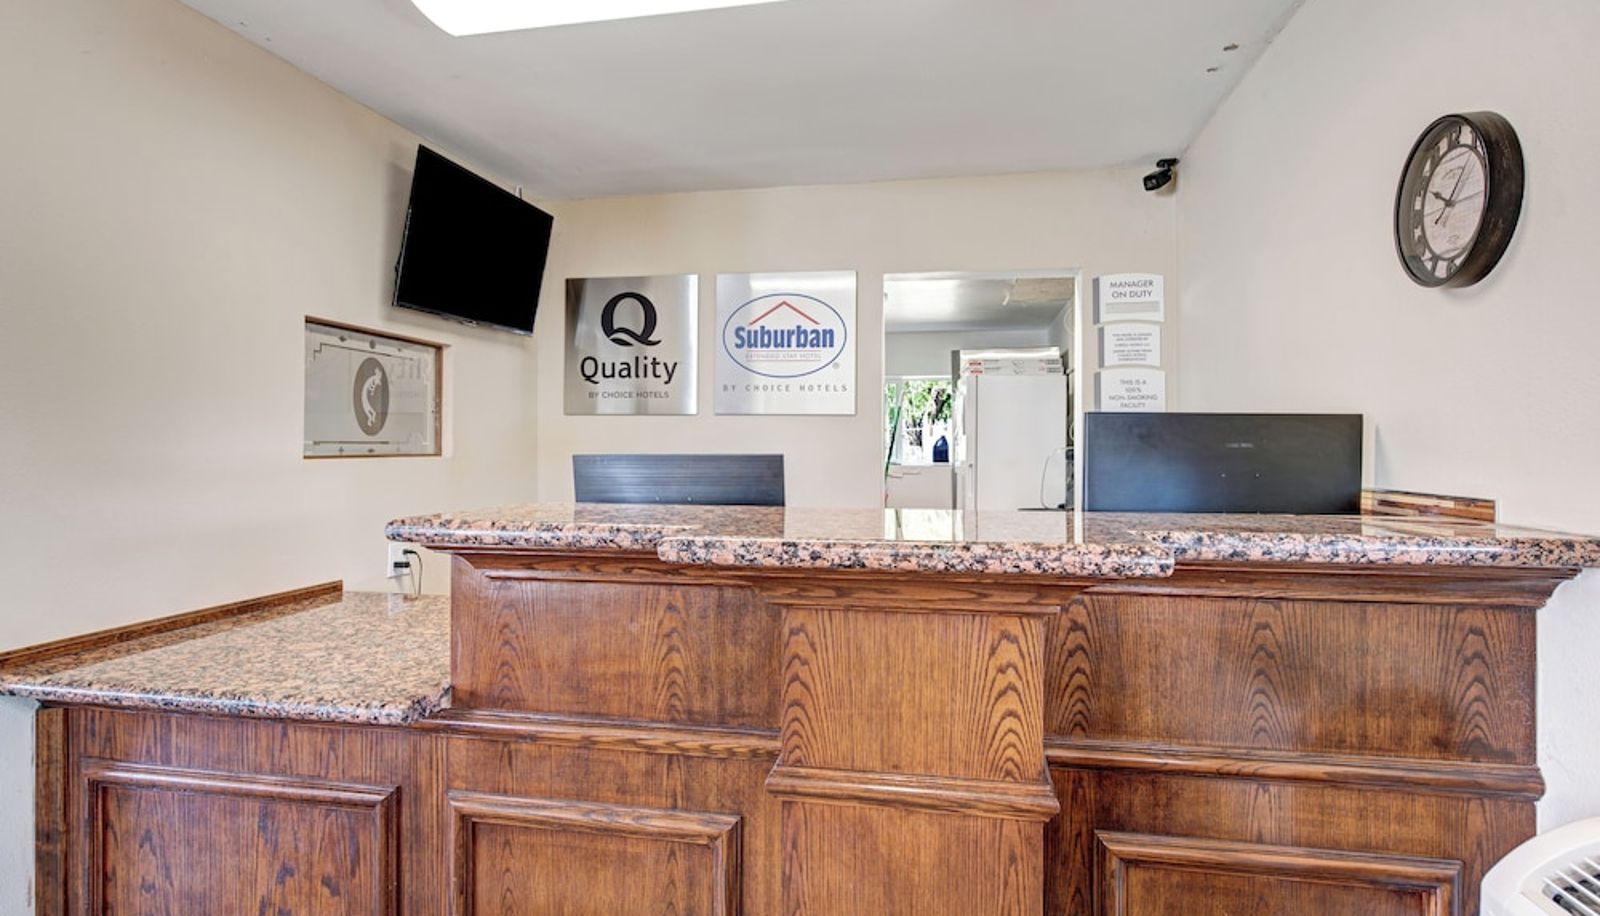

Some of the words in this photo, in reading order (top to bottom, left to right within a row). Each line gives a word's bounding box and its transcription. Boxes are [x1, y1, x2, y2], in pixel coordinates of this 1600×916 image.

[1109, 279, 1154, 288] MANAGER
[1111, 290, 1127, 298] ON
[1129, 290, 1153, 298] DUTY
[601, 292, 662, 347] Q
[734, 325, 835, 349] Suburban
[580, 356, 678, 385] Quality
[722, 384, 737, 392] BY
[745, 384, 791, 392] CHOICE
[799, 383, 848, 392] HOTELS
[588, 391, 599, 399] BY
[601, 391, 634, 399] CHOICE
[636, 391, 670, 399] HOTELS
